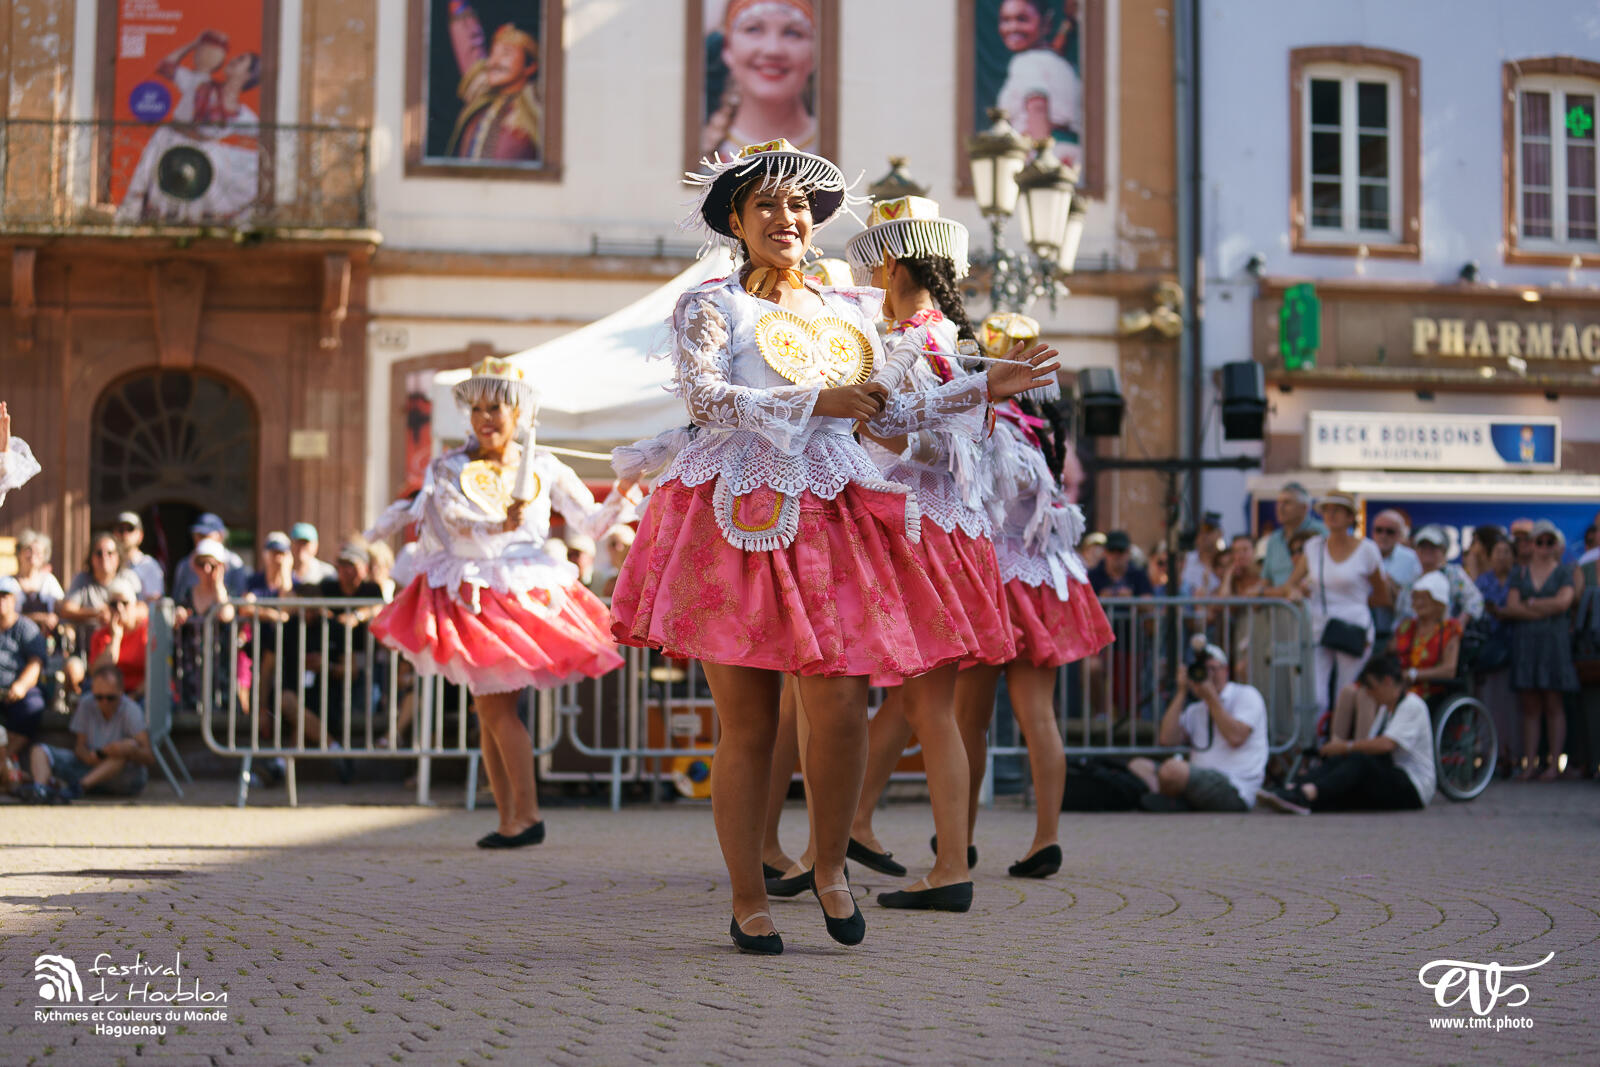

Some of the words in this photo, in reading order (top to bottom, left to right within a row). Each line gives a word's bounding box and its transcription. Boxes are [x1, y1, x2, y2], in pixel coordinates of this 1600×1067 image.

[1411, 317, 1600, 361] PHARMAC
[1317, 426, 1370, 445] BECK
[1381, 427, 1484, 446] BOISSONS
